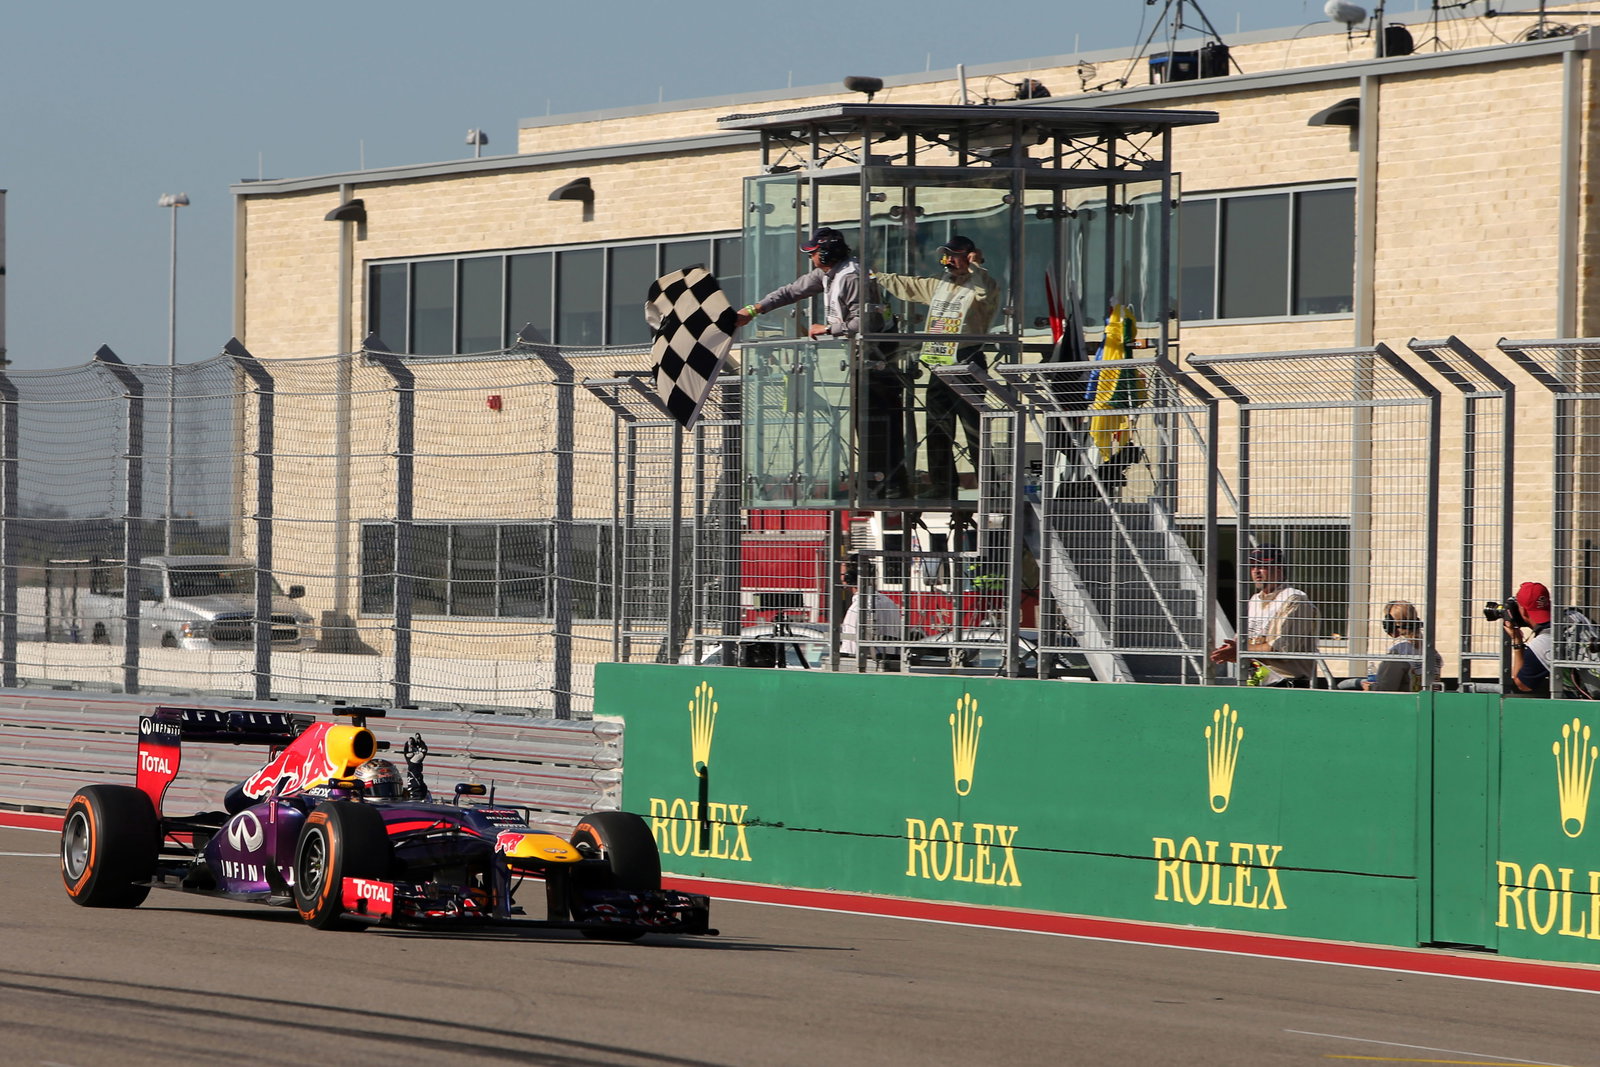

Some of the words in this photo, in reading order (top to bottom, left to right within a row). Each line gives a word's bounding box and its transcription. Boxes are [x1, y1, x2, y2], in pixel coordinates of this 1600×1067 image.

[140, 751, 172, 774] TOTAL
[649, 797, 752, 862] ROLEX
[905, 817, 1022, 887] ROLEX
[221, 860, 295, 885] INFINII
[353, 879, 391, 902] TOTAL
[1152, 836, 1288, 910] ROLEX
